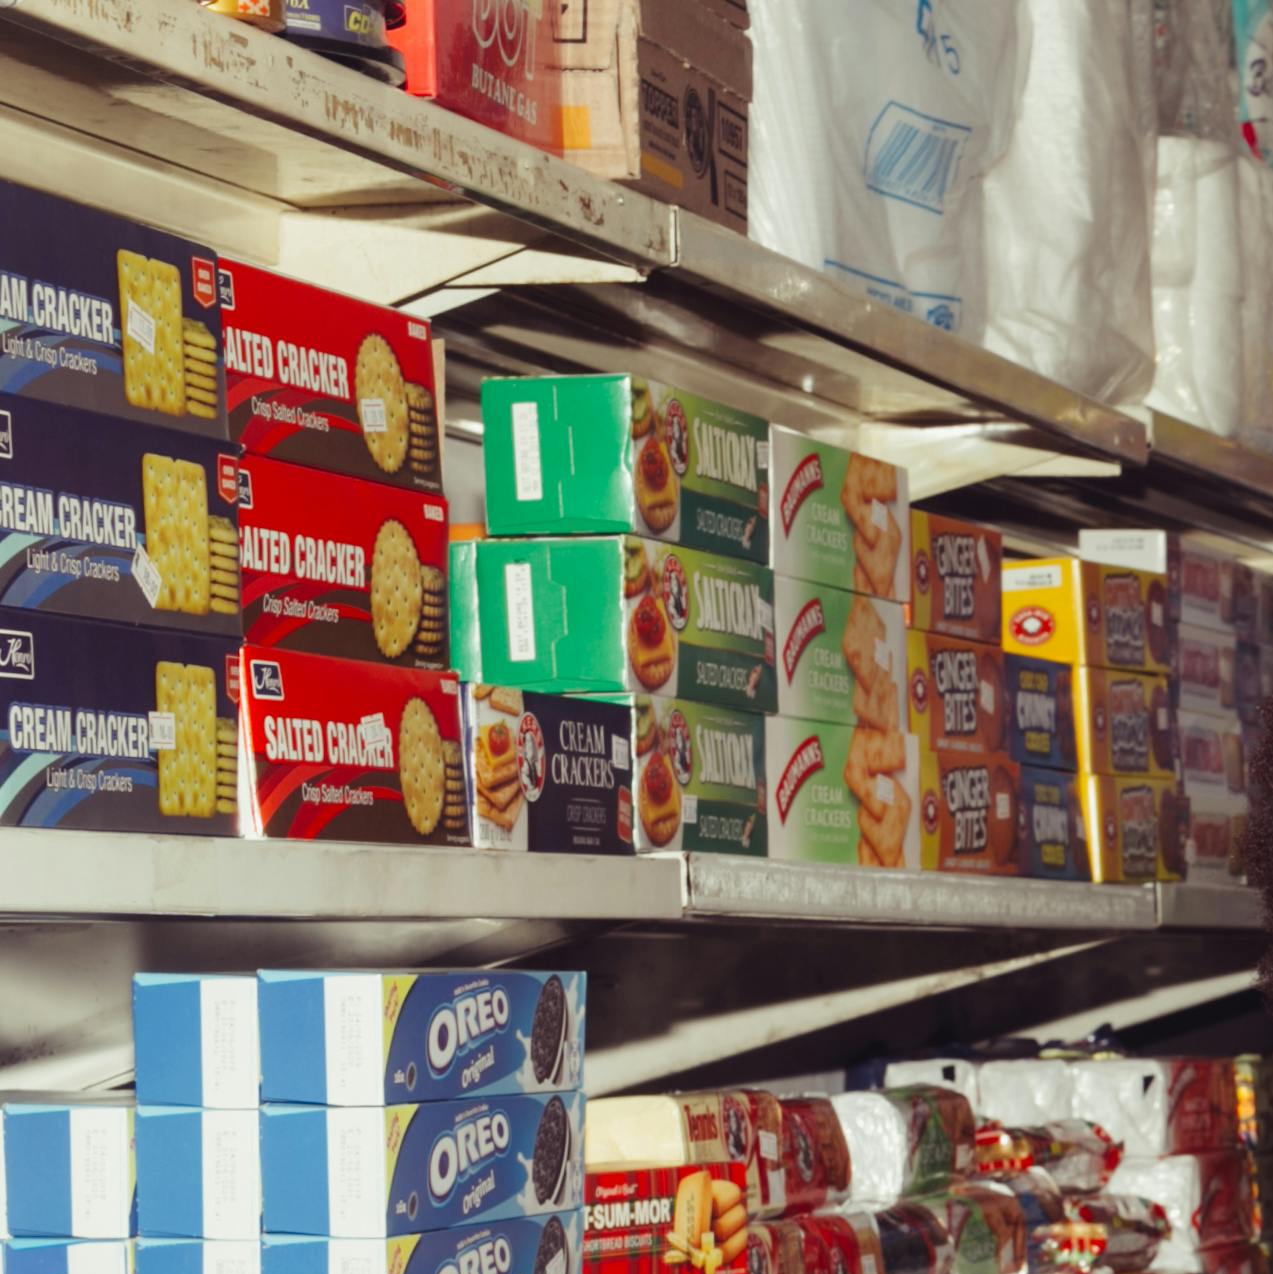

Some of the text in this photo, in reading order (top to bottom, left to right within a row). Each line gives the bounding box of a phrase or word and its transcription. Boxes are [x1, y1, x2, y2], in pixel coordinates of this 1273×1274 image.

[471, 63, 536, 125] BUTANE GAS
[32, 283, 114, 345] CRACKER
[2, 333, 97, 375] Light & Crisp Crackers
[277, 340, 349, 399] CRACKER
[251, 396, 329, 432] Crisp Salted Crackers
[0, 485, 137, 549] REAM CRACKER
[812, 503, 840, 526] CREAM
[807, 525, 848, 551] CRACKERS
[936, 535, 977, 578] GINGER
[26, 548, 49, 574] Light
[51, 553, 59, 566] &
[60, 552, 82, 579] Crisp
[84, 556, 120, 582] Crackers
[294, 534, 365, 588] CRACKER
[263, 593, 339, 624] Crisp Salted Crackers
[944, 578, 973, 619] BITES
[814, 648, 842, 668] CREAM
[935, 649, 978, 695] GINGER
[808, 670, 849, 694] CRACKERS
[9, 705, 71, 752] CREAM
[75, 711, 149, 759] CRACKER
[944, 691, 977, 734] BITES
[264, 715, 324, 762] SALTED
[559, 720, 605, 755] CREAM
[46, 766, 133, 794] Light & Crisp Crackers
[552, 753, 615, 789] CRACKERS
[947, 768, 989, 812] GINGER
[302, 783, 374, 805] Crisp Salted Crackers
[812, 784, 843, 803] CREAM
[805, 806, 850, 830] CRACKERS
[955, 806, 988, 854] BITES
[428, 989, 509, 1069] OREO
[461, 1045, 495, 1088] Original
[429, 1112, 510, 1196] OREO
[462, 1177, 495, 1214] Original
